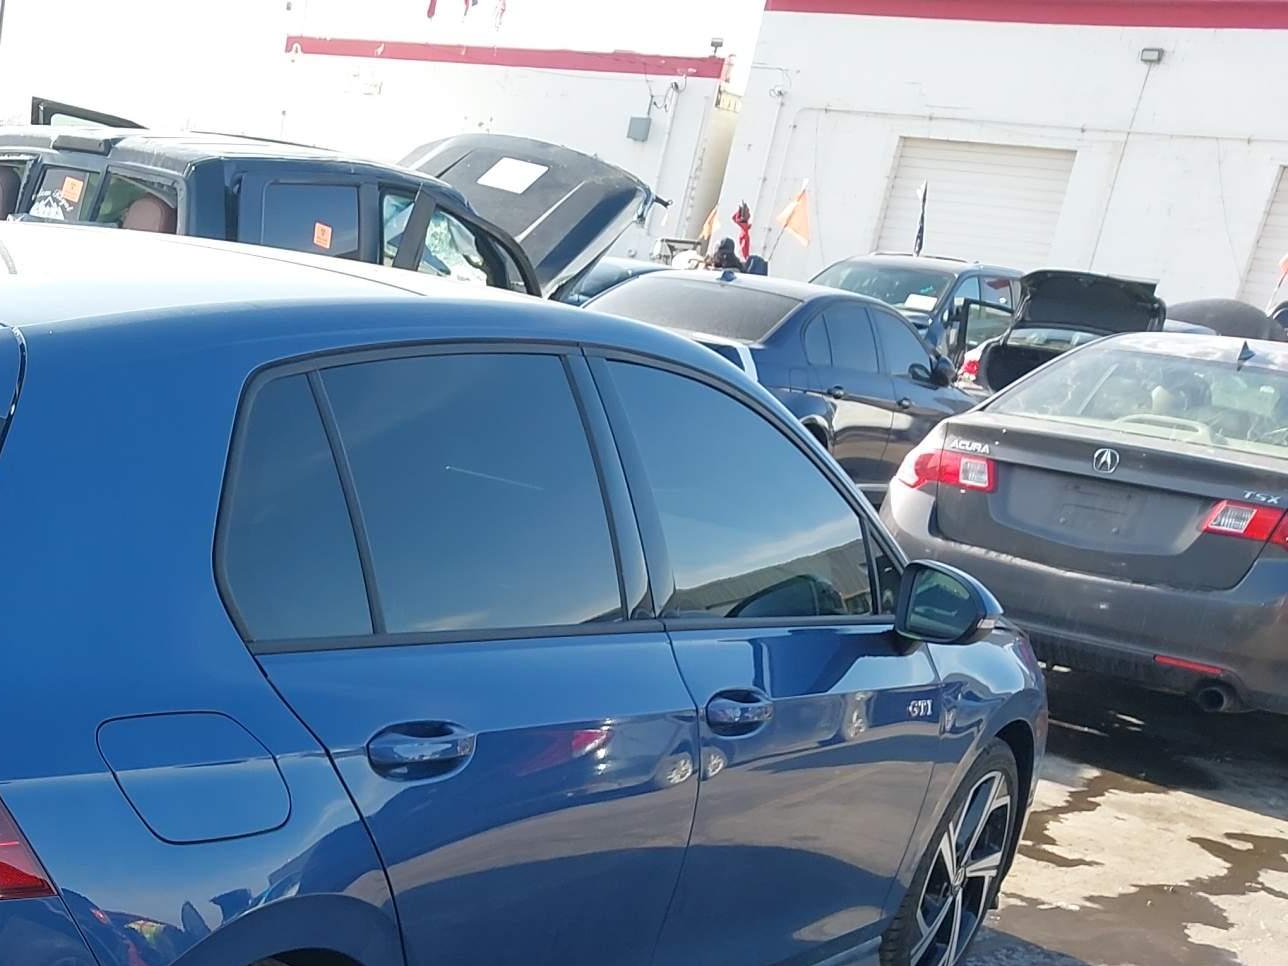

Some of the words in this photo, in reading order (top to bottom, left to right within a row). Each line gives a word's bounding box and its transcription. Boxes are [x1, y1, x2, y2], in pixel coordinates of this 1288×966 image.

[950, 439, 990, 454] ACURA
[1242, 489, 1281, 505] TSX
[908, 699, 933, 717] GTI
